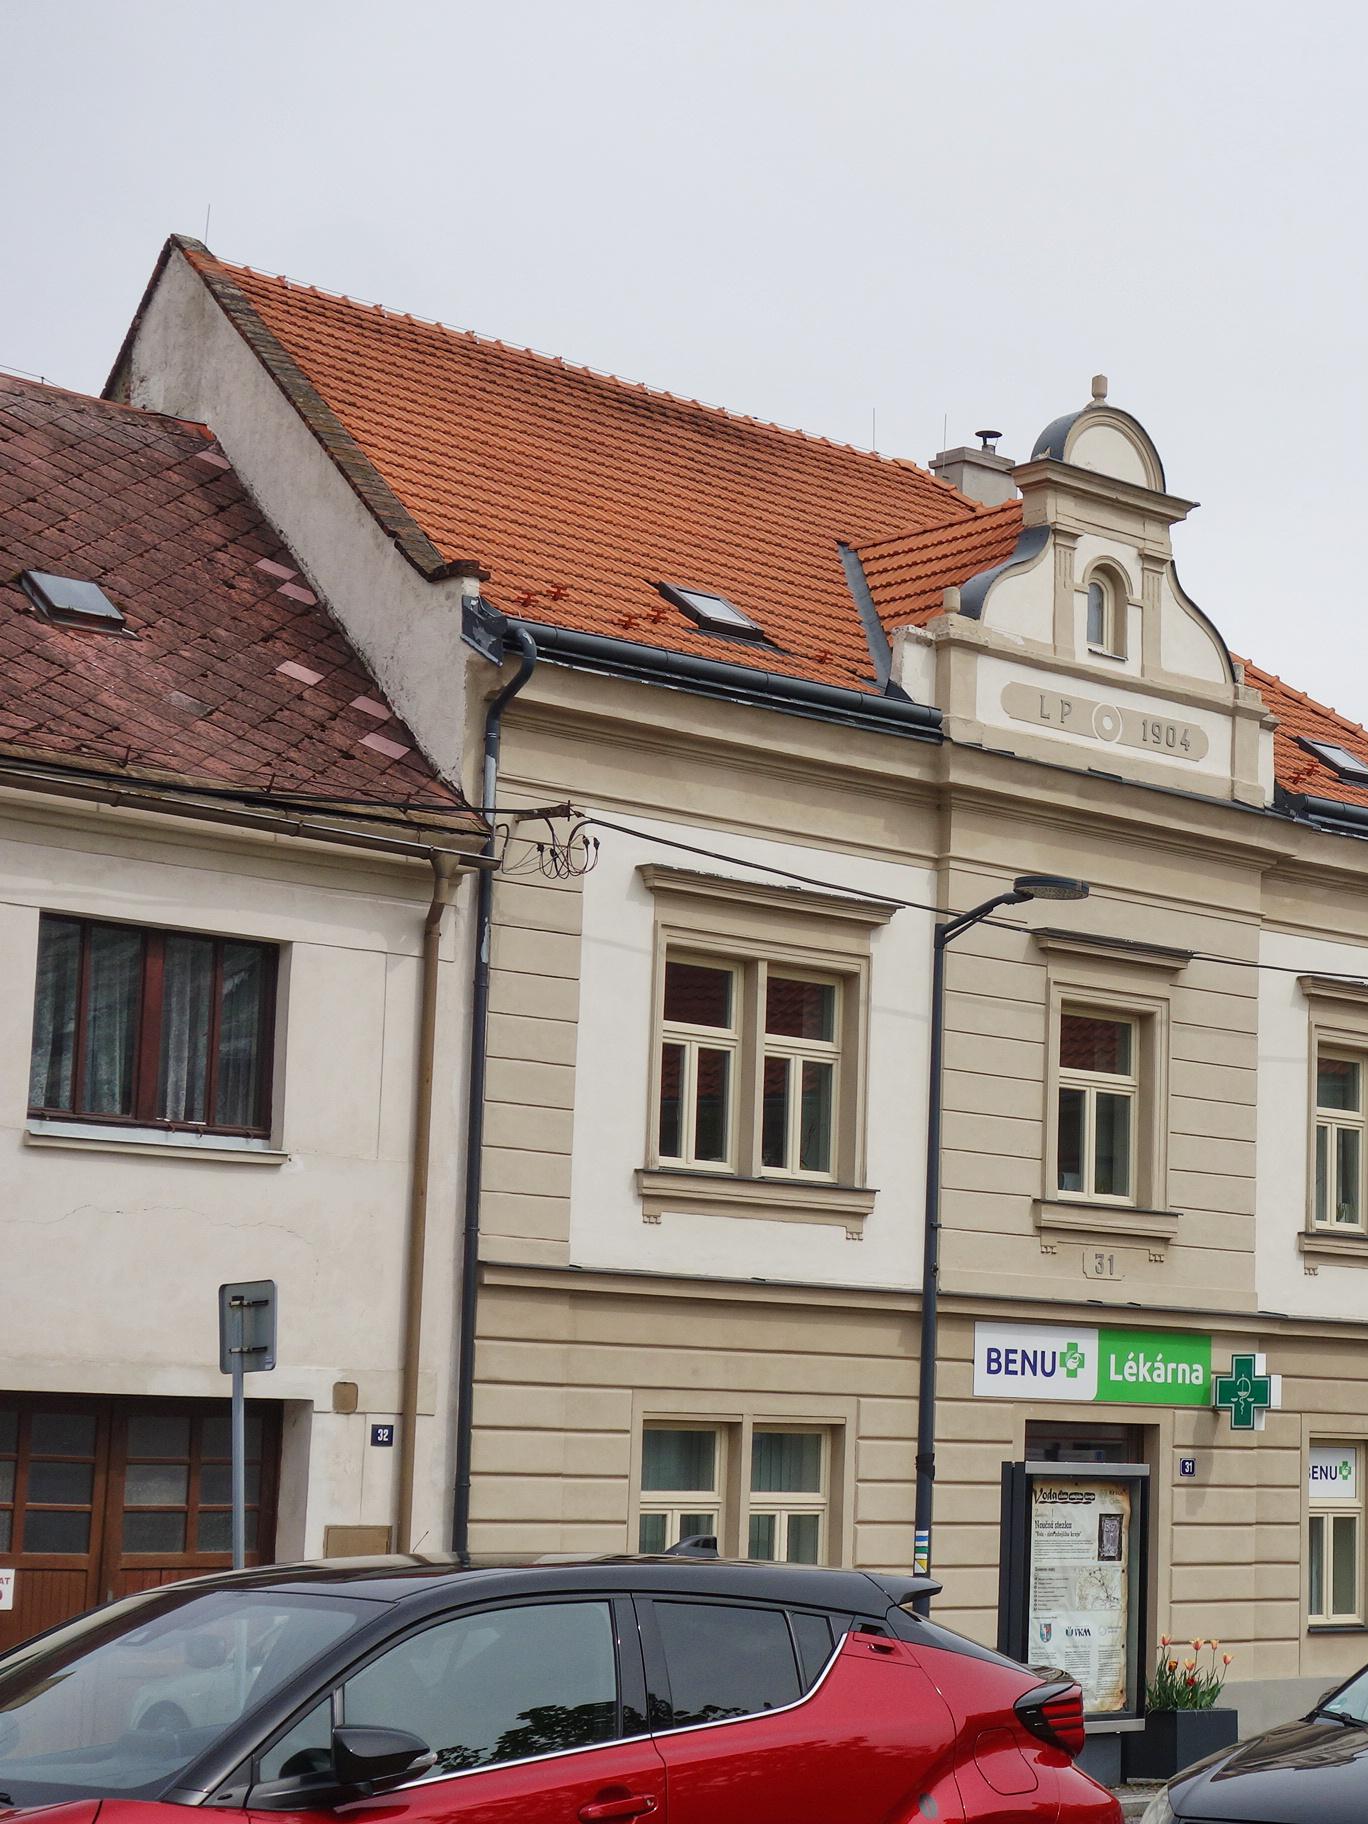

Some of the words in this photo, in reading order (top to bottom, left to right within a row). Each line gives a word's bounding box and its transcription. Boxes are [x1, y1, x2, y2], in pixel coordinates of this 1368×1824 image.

[1141, 719, 1191, 752] 1904
[1095, 1253, 1114, 1276] 31
[986, 1347, 1057, 1378] BENU
[1109, 1351, 1204, 1385] Lékárna
[377, 1428, 389, 1441] 32
[1184, 1461, 1193, 1473] 31
